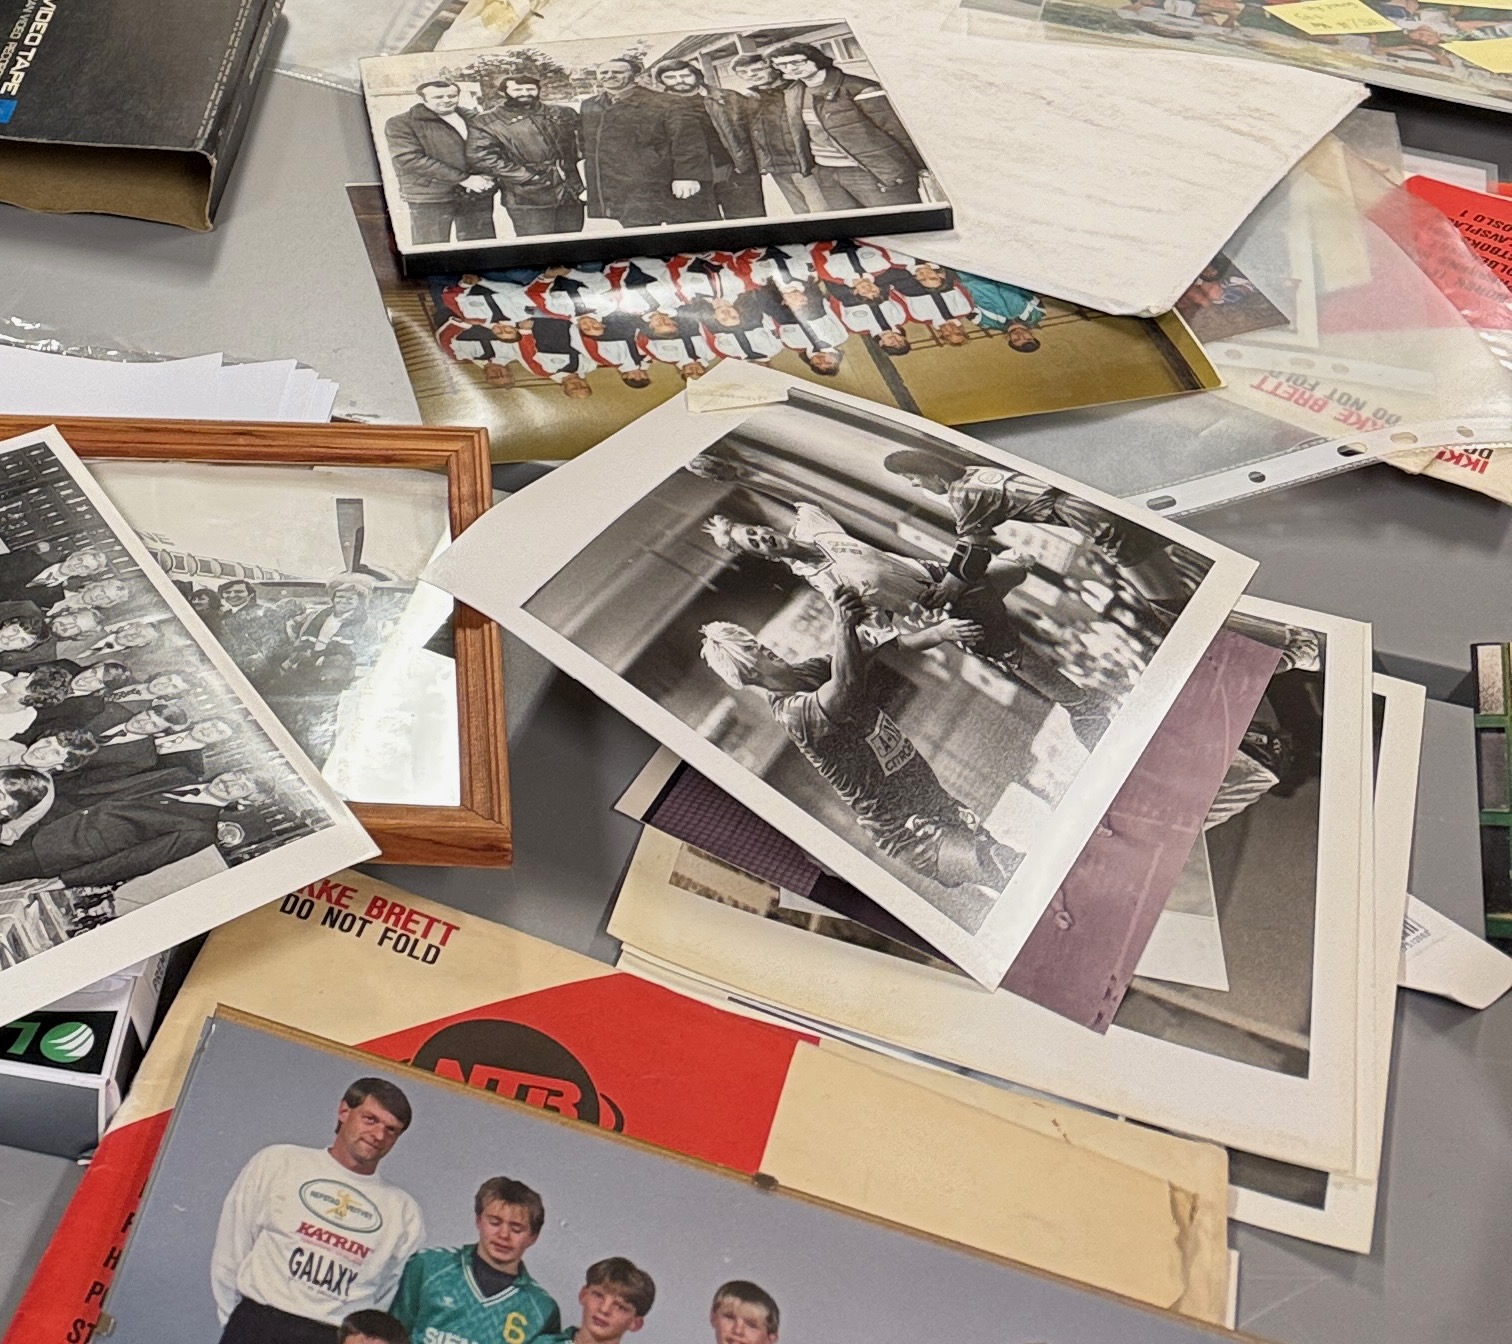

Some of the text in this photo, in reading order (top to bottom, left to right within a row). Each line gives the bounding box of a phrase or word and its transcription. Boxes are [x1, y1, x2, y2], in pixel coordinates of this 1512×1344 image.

[9, 13, 30, 40] VIDEO
[0, 47, 38, 97] TAPE
[1250, 372, 1331, 413] BRETT
[1323, 387, 1368, 412] NOT
[1371, 406, 1402, 426] DO
[279, 893, 442, 966] DO NOT FOLD
[363, 895, 461, 948] BRETT
[296, 1221, 372, 1260] KATRIN
[288, 1246, 359, 1297] GALAXY
[502, 1311, 528, 1344] 6
